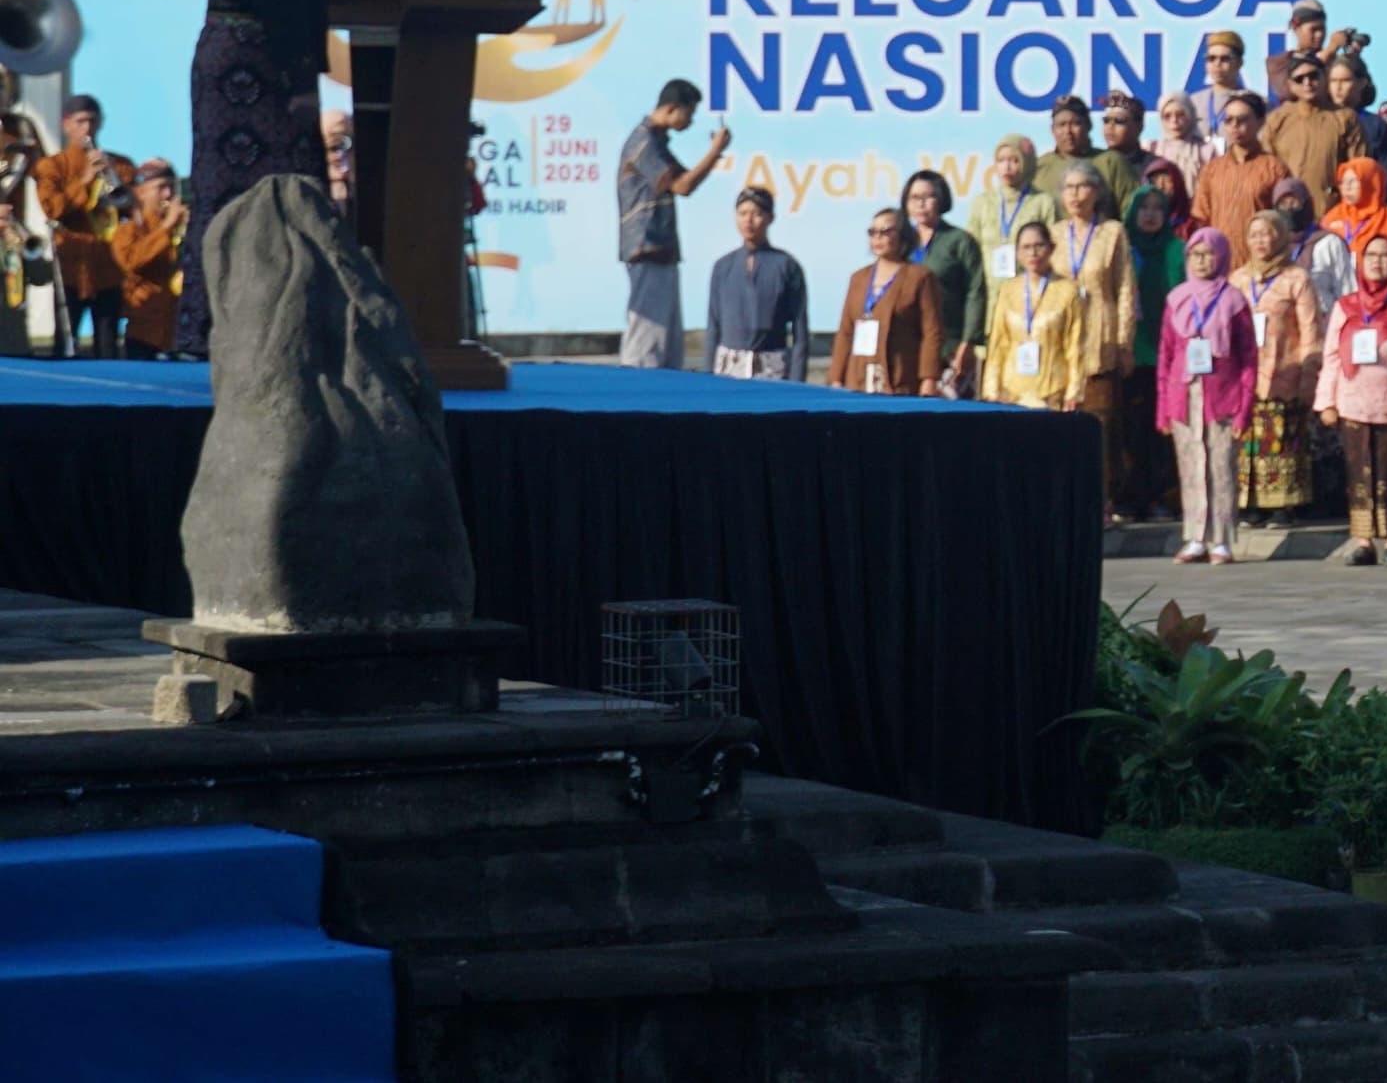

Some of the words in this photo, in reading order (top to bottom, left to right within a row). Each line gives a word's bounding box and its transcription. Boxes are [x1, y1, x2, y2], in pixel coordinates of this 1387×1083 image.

[544, 115, 571, 133] 29
[544, 139, 597, 157] JUNI
[544, 164, 600, 182] 2026
[508, 200, 567, 214] HADIR
